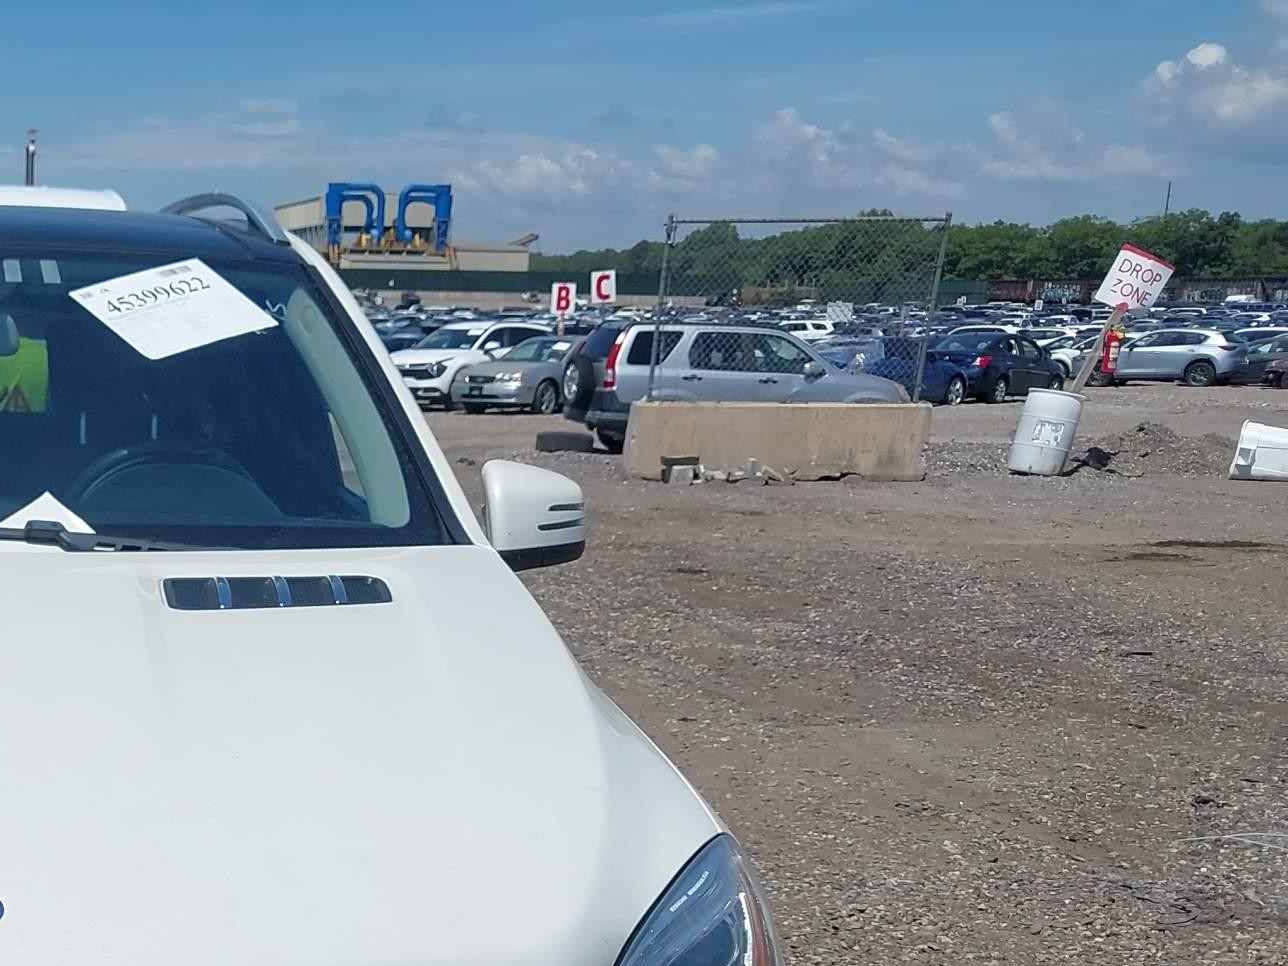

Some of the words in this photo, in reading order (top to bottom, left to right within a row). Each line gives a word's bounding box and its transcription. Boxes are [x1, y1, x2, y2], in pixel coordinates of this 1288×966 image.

[1118, 258, 1163, 286] DROP
[107, 276, 210, 314] 45399622
[556, 286, 570, 311] B
[596, 274, 611, 301] C
[1110, 278, 1152, 307] ZONE
